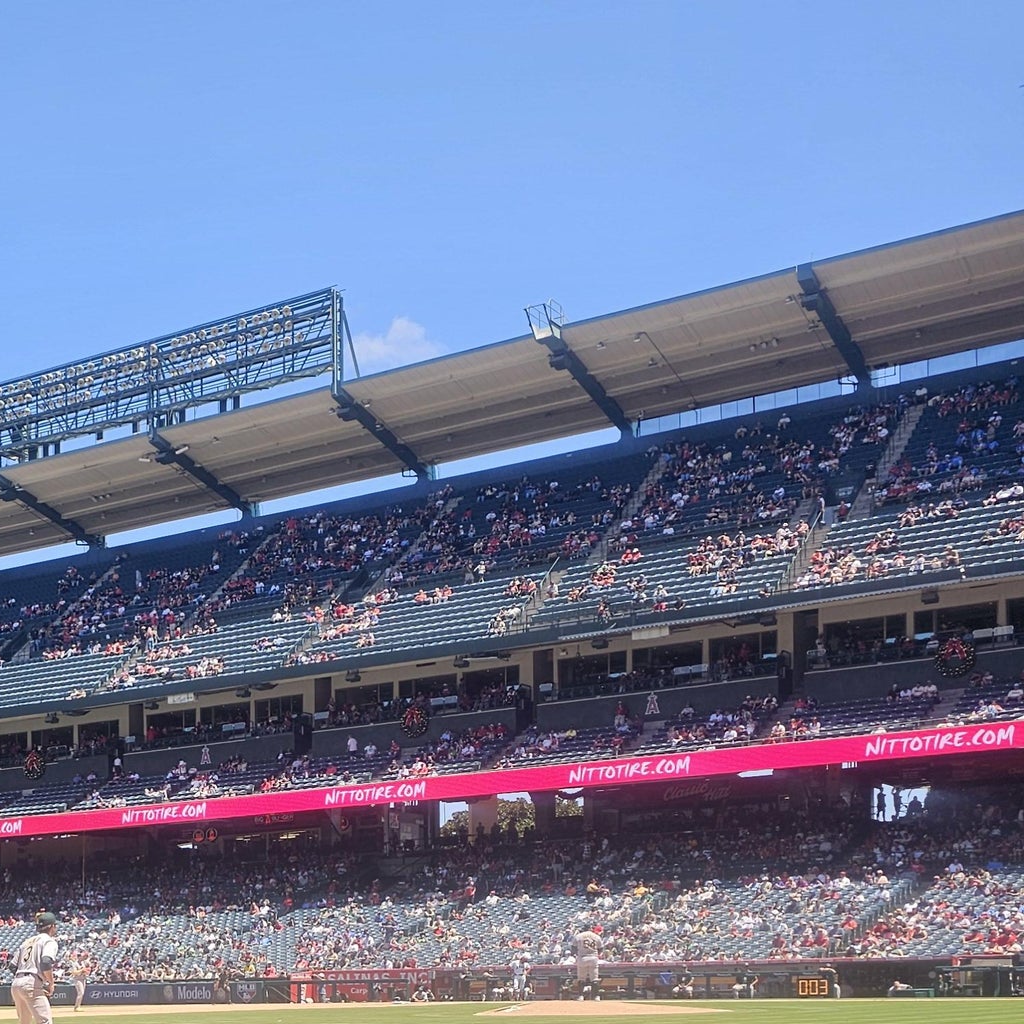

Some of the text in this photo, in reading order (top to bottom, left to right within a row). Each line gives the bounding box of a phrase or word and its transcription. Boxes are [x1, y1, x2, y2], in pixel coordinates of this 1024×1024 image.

[866, 724, 1015, 757] NITTOTIRE.COM
[569, 756, 691, 783] NITTOTIRE.COM
[325, 781, 426, 805] NITTOTIRE.COM
[122, 802, 207, 824] NITTOTIRE.COM
[24, 945, 33, 962] 3
[177, 986, 211, 1000] Modelo
[799, 980, 828, 995] 003
